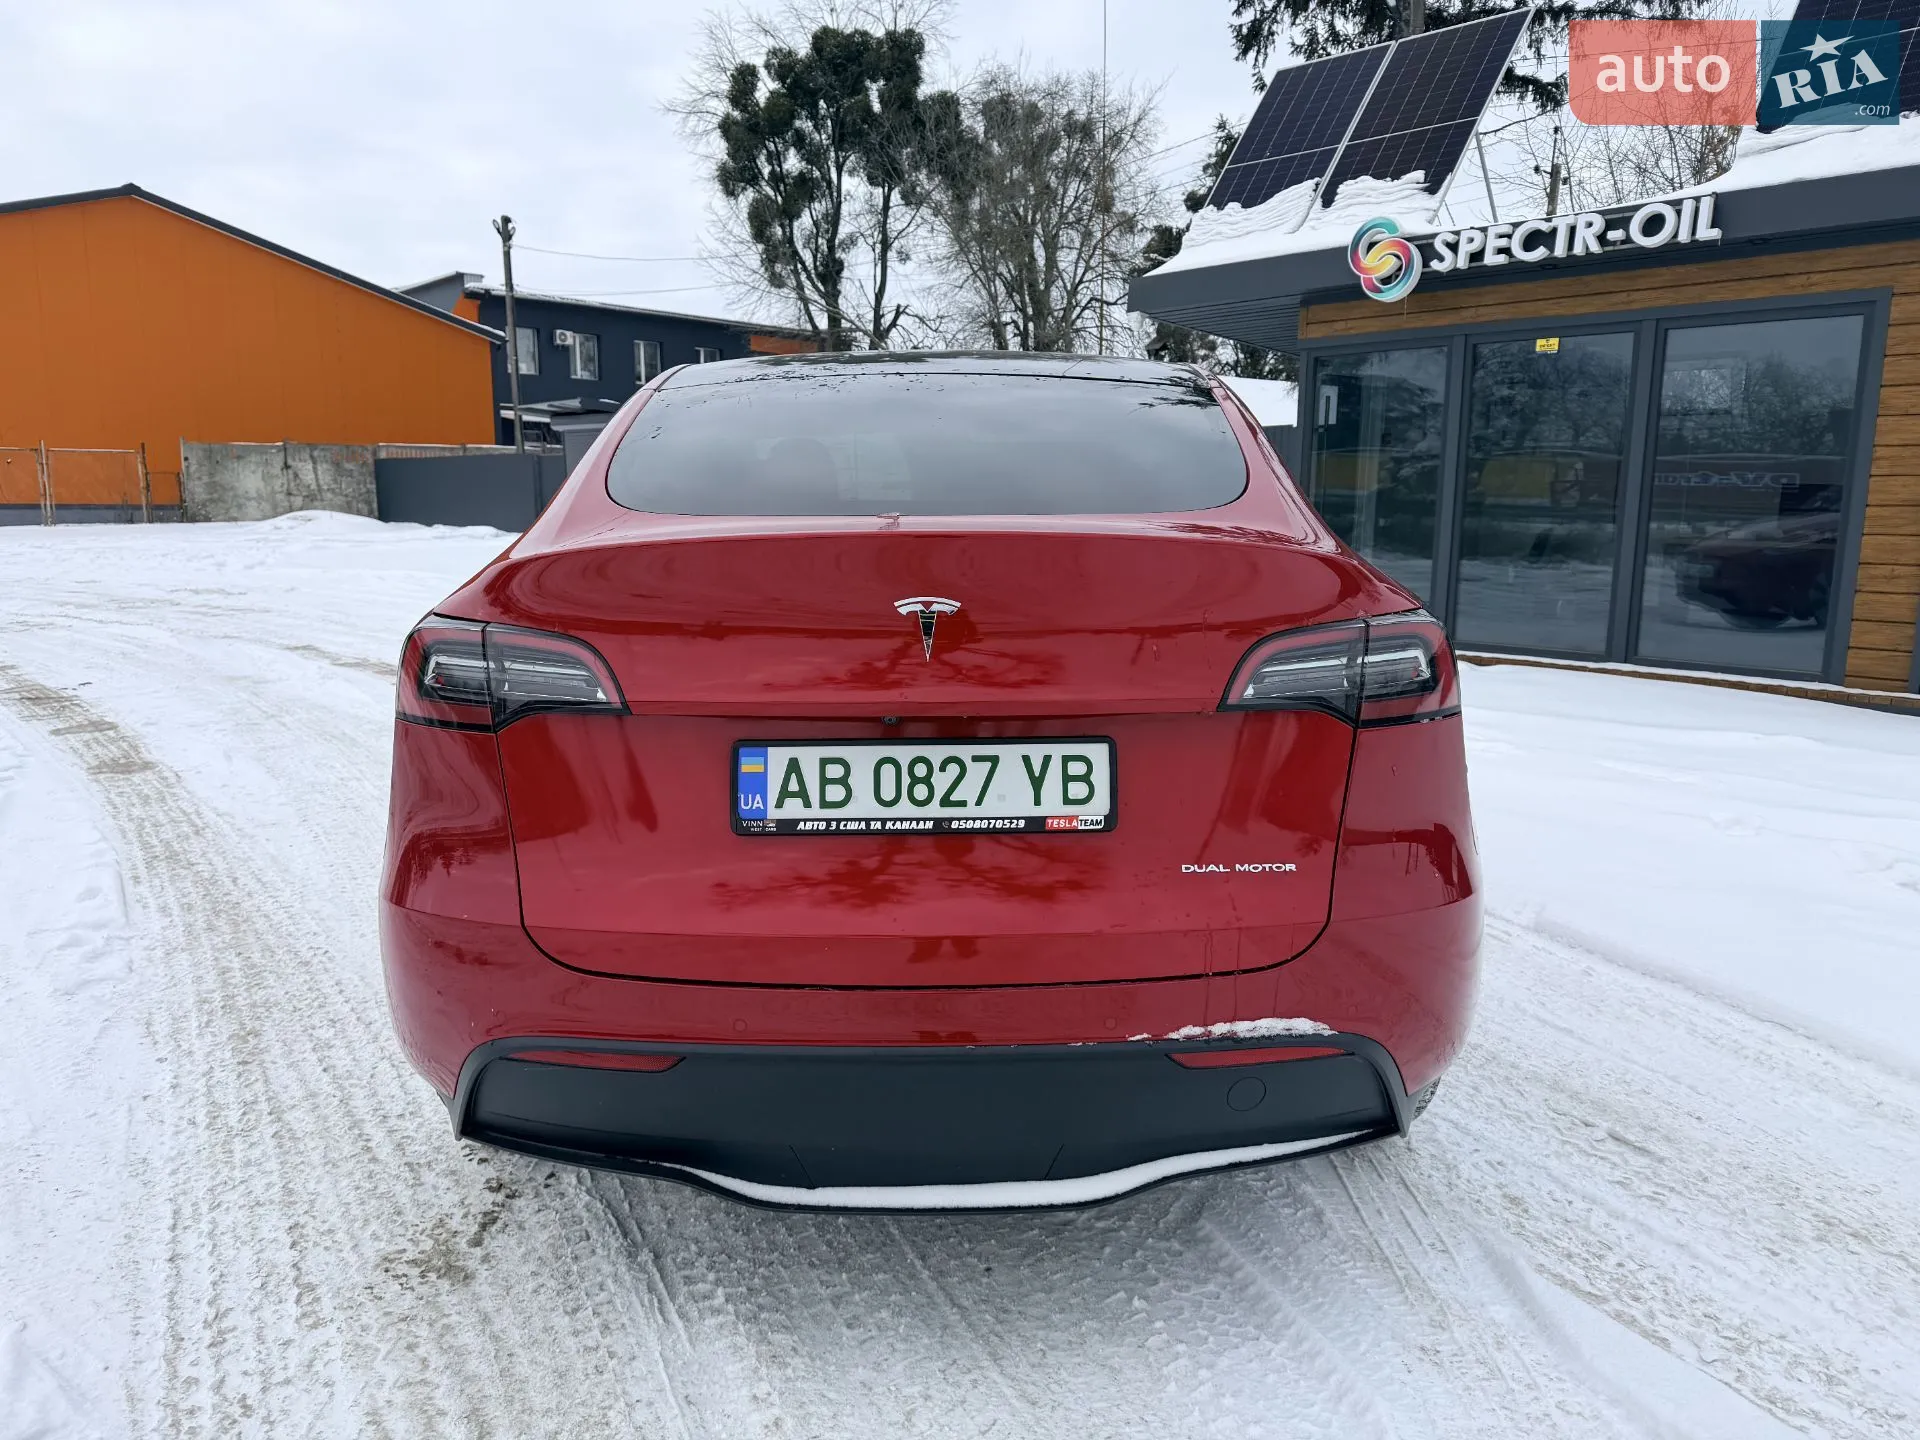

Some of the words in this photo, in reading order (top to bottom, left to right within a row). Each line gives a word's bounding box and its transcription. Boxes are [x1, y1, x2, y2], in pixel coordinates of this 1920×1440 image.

[1430, 195, 1722, 273] SPECTR-OIL
[774, 757, 852, 809] AB
[872, 754, 1000, 808] 0827
[1021, 753, 1095, 806] YB
[740, 793, 764, 810] UA
[742, 820, 763, 828] VINN
[797, 821, 827, 831] АВТО
[839, 821, 867, 830] США
[950, 819, 1026, 829] 0508070529
[1181, 863, 1230, 873] DUAL
[1235, 863, 1297, 873] MOTOR
